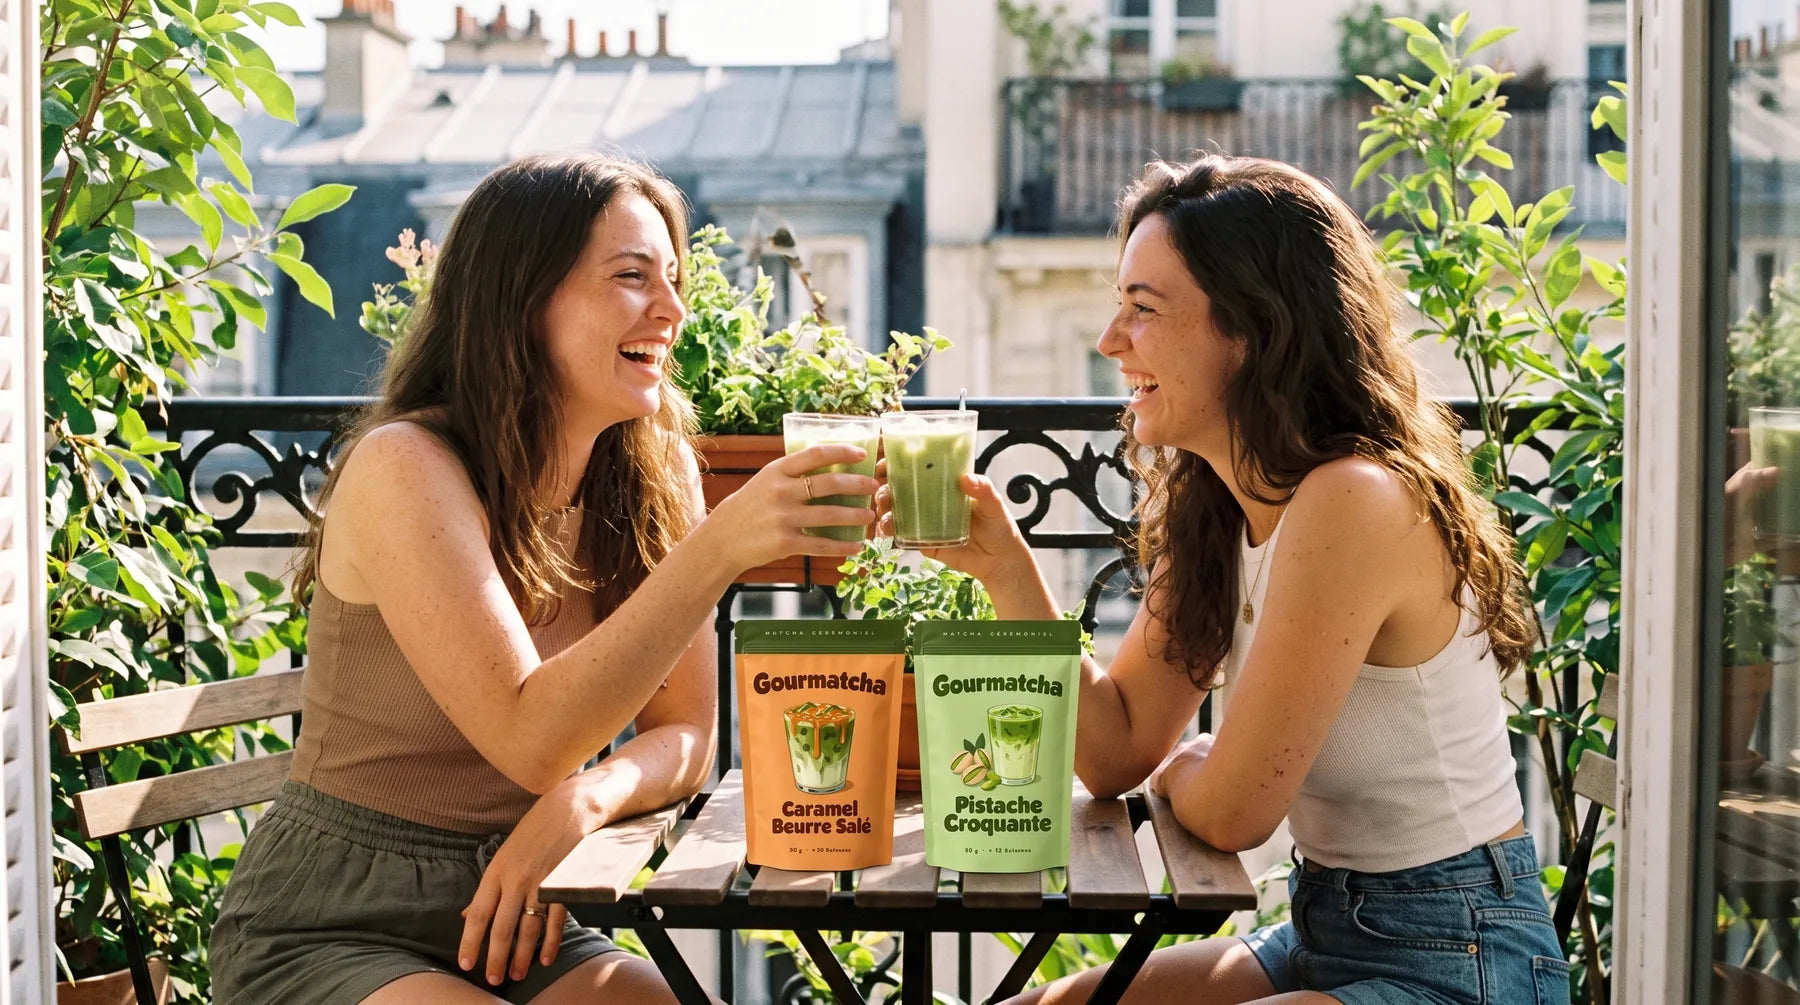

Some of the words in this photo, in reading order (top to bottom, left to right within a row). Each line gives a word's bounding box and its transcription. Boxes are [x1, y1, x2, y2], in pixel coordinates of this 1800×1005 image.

[753, 671, 887, 696] Gourmatcha
[932, 673, 1064, 698] Gourmatcha
[781, 800, 858, 817] Caramel
[955, 795, 1043, 815] Pistache
[772, 818, 831, 834] Beurre
[836, 815, 872, 834] Salé
[943, 813, 1052, 837] Croquante
